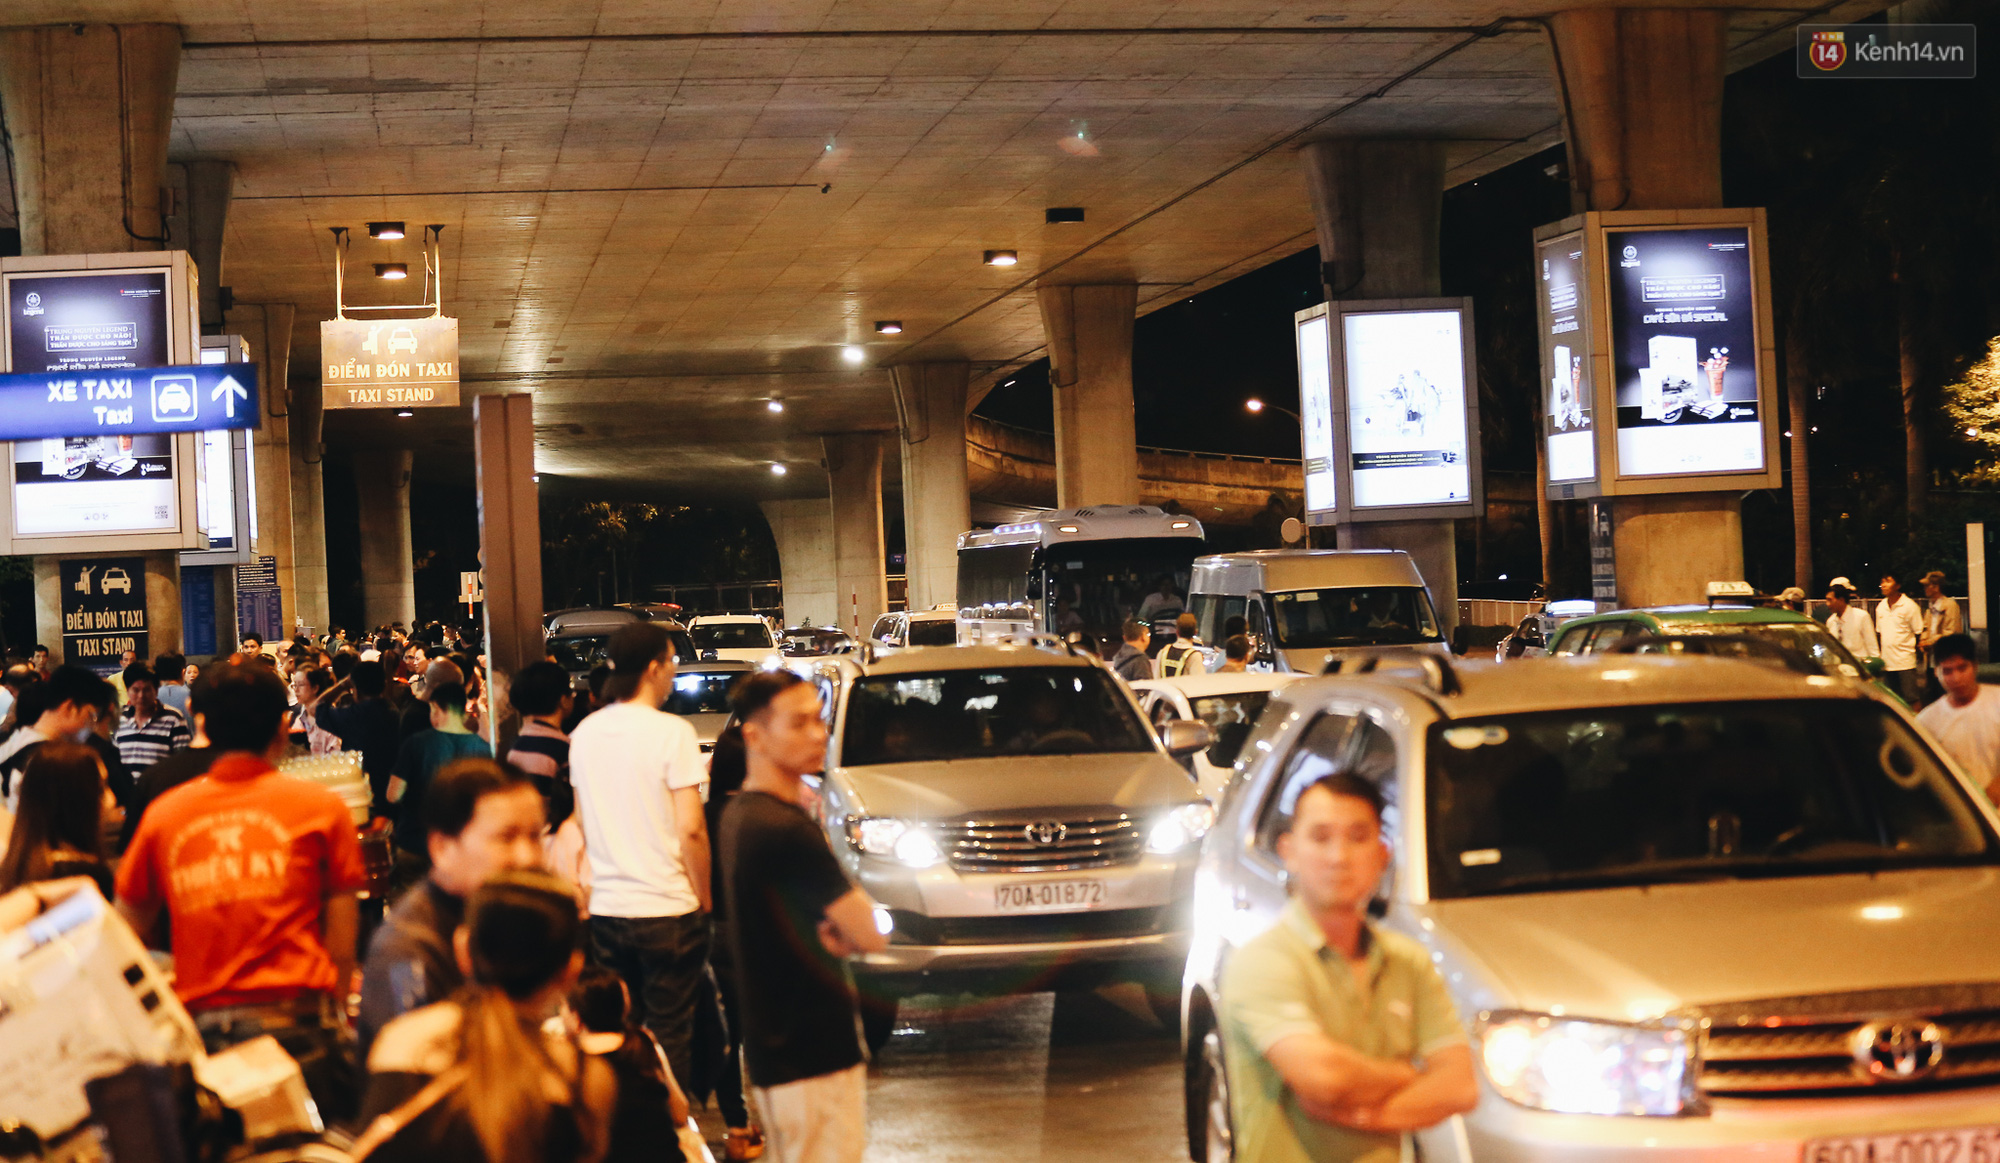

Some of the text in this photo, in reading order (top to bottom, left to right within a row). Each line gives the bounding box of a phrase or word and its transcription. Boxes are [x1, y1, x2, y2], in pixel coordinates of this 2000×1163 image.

[328, 358, 452, 379] ĐIỂM ĐÓN TAXI
[47, 378, 132, 402] XE TAXI
[348, 387, 434, 402] TAXI STAND
[93, 405, 133, 425] Taxi
[66, 604, 143, 630] ĐIỂM ĐÓN TAXI
[76, 637, 135, 656] TAXI STAND
